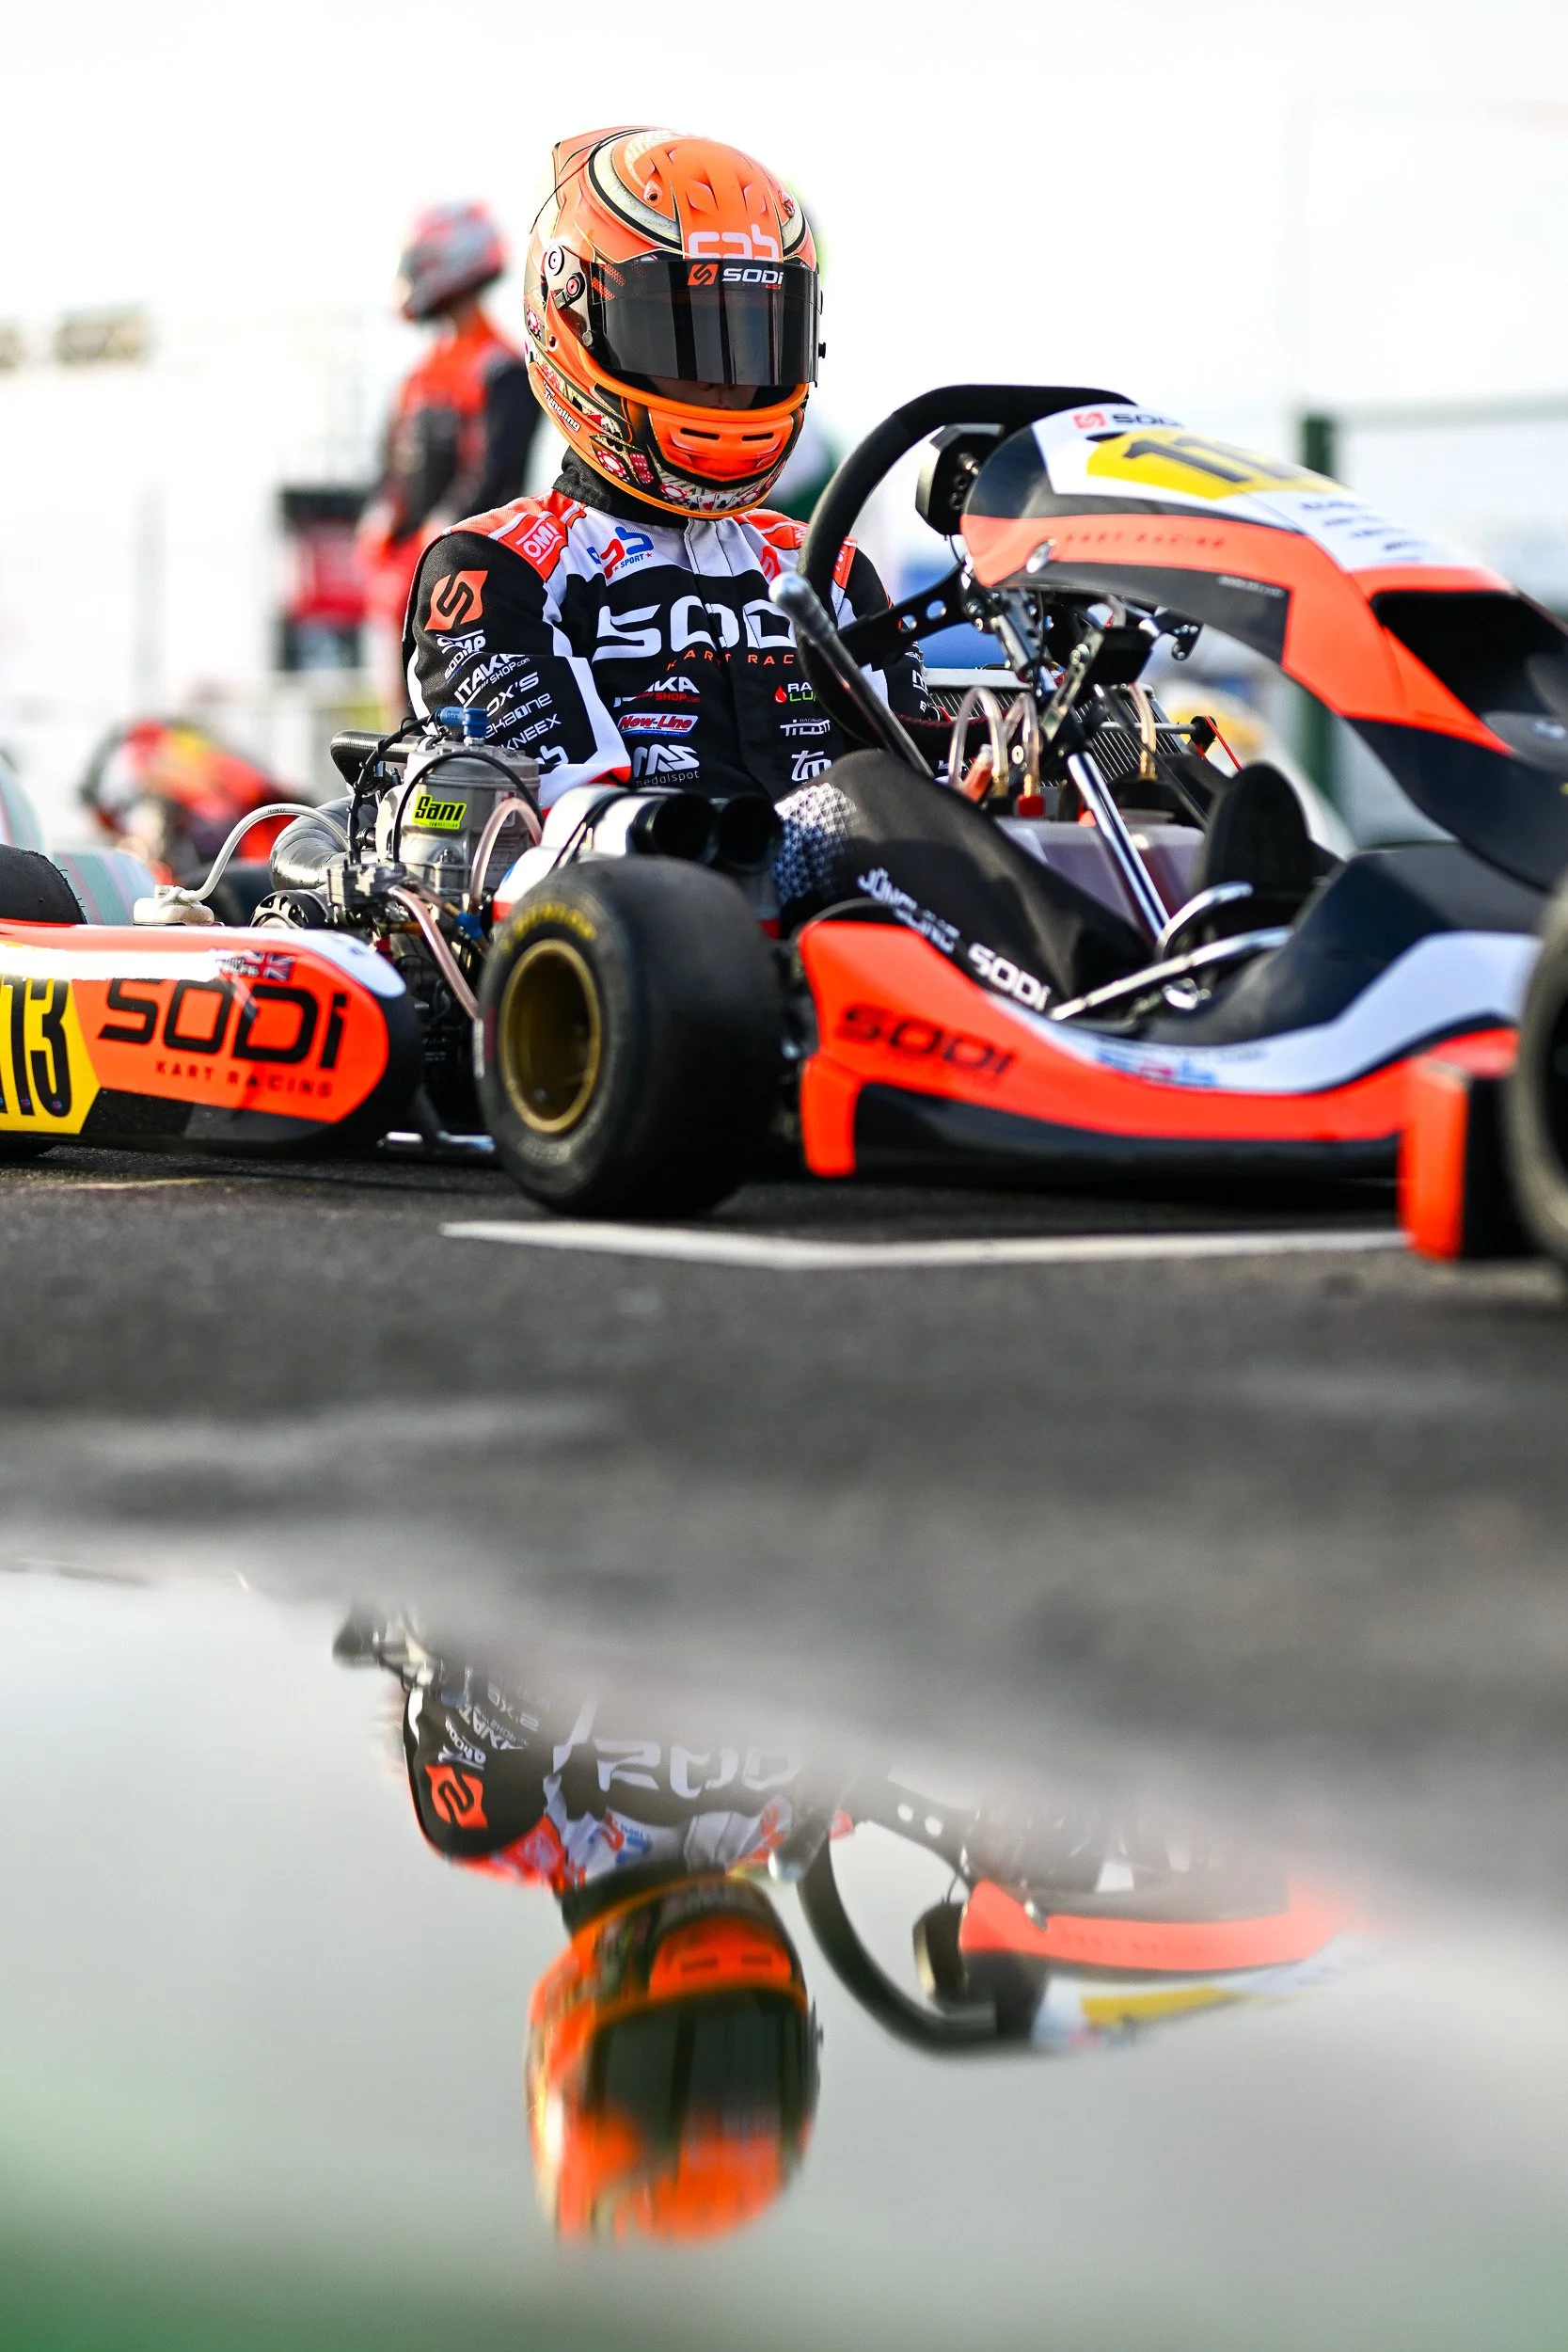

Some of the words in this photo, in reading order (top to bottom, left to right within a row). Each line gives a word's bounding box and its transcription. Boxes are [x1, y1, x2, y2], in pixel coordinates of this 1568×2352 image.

[620, 553, 644, 568] SPORT
[593, 595, 798, 663] SOD
[748, 653, 795, 666] RAC
[0, 974, 72, 1118] 13
[155, 1060, 214, 1083] KART
[227, 1070, 333, 1098] RACING
